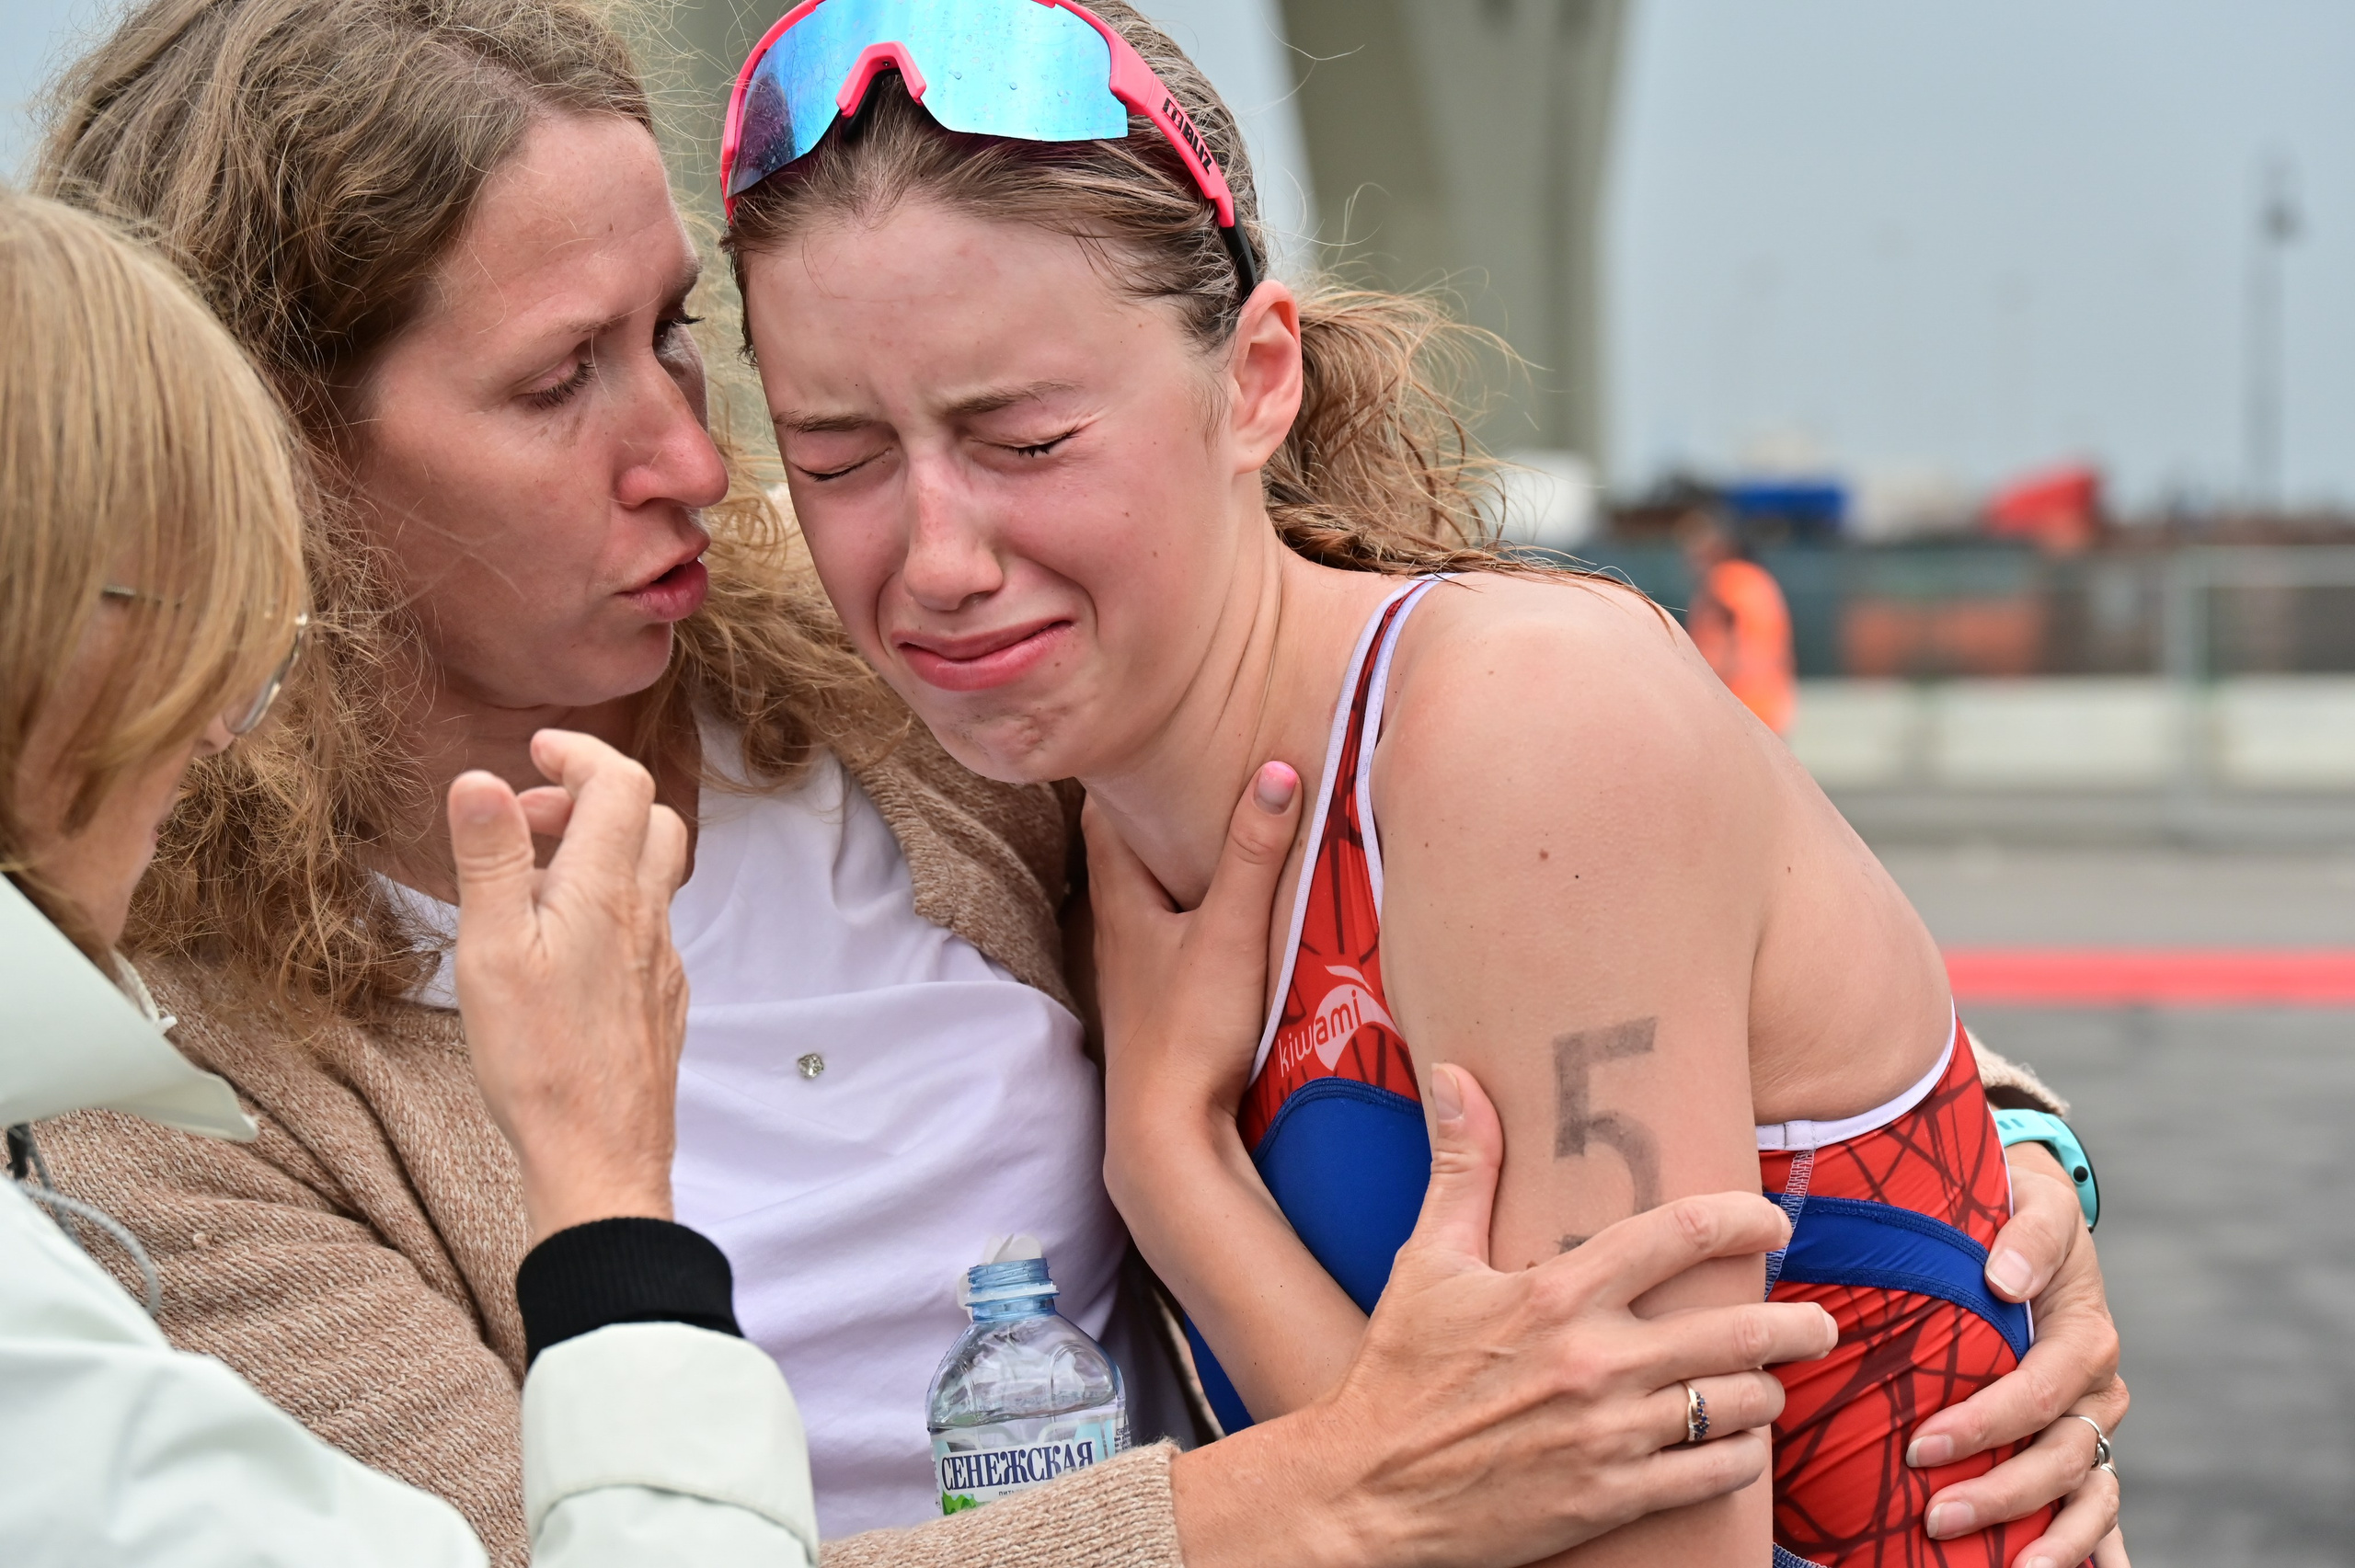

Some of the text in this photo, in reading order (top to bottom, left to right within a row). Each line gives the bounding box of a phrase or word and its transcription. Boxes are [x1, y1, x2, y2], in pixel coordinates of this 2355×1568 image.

[1278, 990, 1362, 1078] kiwami
[1553, 1015, 1662, 1254] 5
[941, 1440, 1094, 1491] СЕНЕЖСКАЯ
